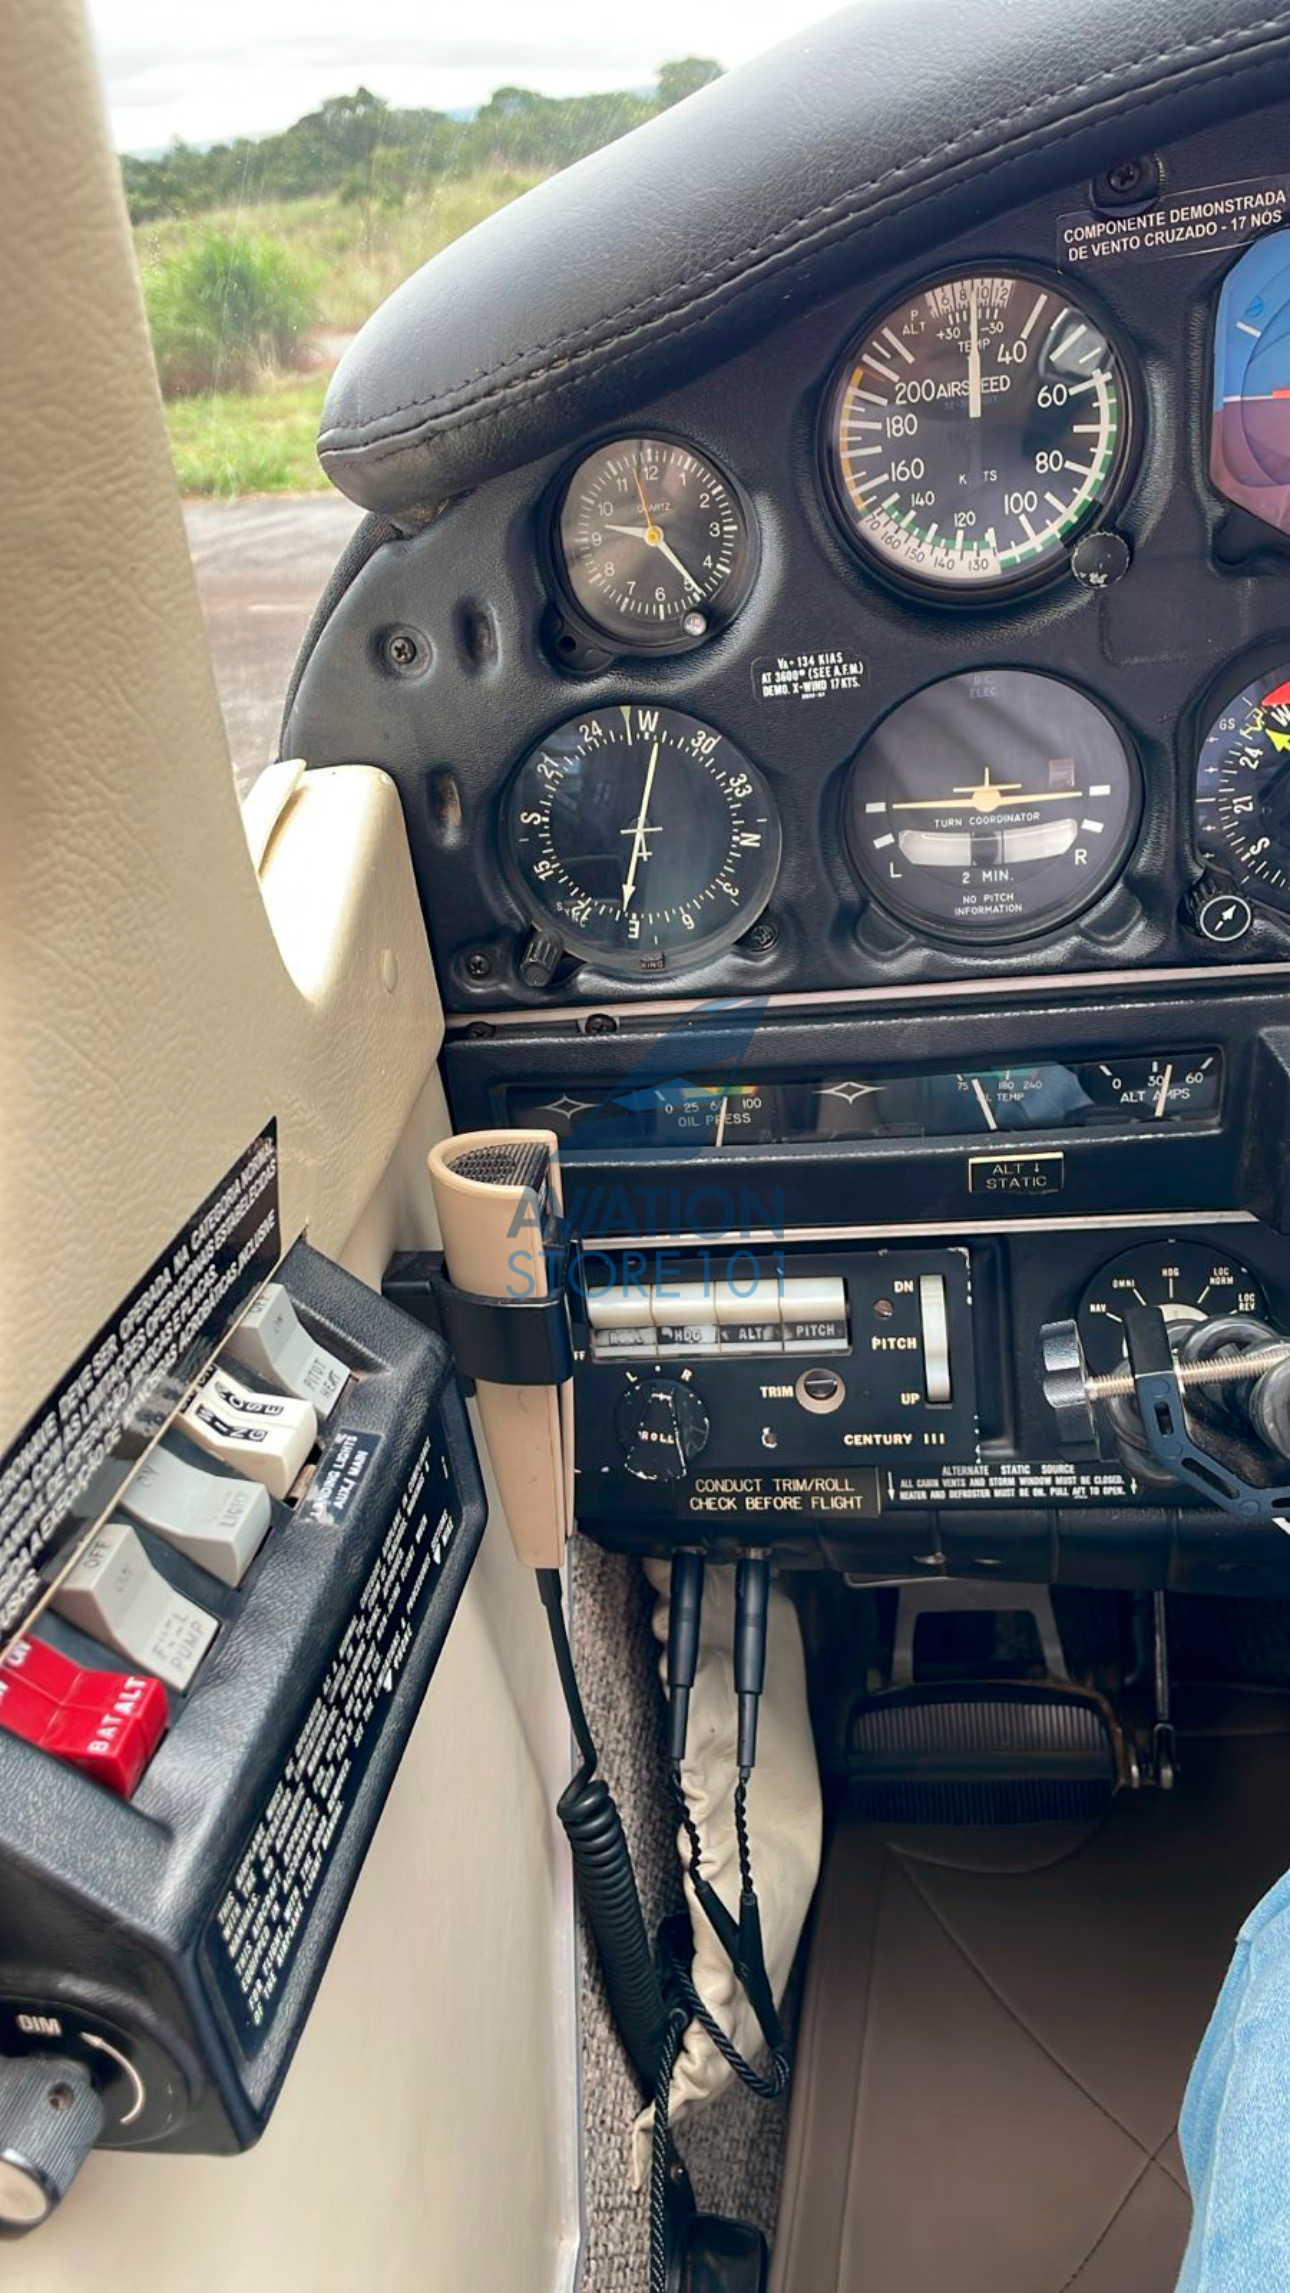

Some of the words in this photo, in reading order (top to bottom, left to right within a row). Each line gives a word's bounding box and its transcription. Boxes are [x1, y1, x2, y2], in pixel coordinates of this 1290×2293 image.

[1064, 211, 1165, 243] COMPONENTE
[1170, 190, 1286, 223] DEMONSTRADA
[1068, 246, 1088, 262] DE
[1091, 236, 1140, 257] VENTO
[1144, 222, 1217, 246] CRUZADO
[1231, 216, 1246, 231] 17
[911, 309, 918, 320] P
[902, 322, 926, 335] ALT
[936, 327, 961, 340] +30
[980, 321, 1004, 334] -30
[997, 340, 1027, 364] 40
[895, 379, 936, 404] 200
[936, 374, 1011, 399] AIRSEED
[1037, 384, 1066, 407] 60
[886, 415, 918, 438] 180
[891, 458, 924, 480] 160
[1035, 451, 1062, 474] 80
[642, 465, 659, 481] 12
[616, 478, 629, 492] 11
[699, 492, 711, 509] 2
[911, 490, 935, 506] 140
[1004, 492, 1038, 514] 100
[598, 501, 613, 516] 10
[954, 511, 976, 527] 120
[709, 521, 721, 537] 3
[591, 532, 602, 547] 9
[880, 531, 901, 550] 160
[702, 554, 713, 569] 4
[905, 546, 925, 563] 150
[604, 562, 616, 577] 8
[934, 556, 955, 570] 140
[968, 558, 989, 571] 130
[626, 581, 636, 596] 7
[654, 586, 666, 601] 6
[797, 655, 815, 668] 134
[818, 651, 843, 665] KIAS
[762, 672, 772, 684] AT
[638, 710, 659, 732] W
[1219, 718, 1236, 731] GS
[579, 720, 603, 743] 24
[691, 730, 716, 754] 30
[1239, 746, 1264, 770] 24
[537, 755, 560, 779] 21
[729, 773, 753, 798] 33
[1233, 795, 1253, 815] 21
[520, 811, 541, 825] S
[934, 817, 963, 829] TURN
[969, 811, 1040, 826] COORDINATOR
[739, 832, 761, 848] N
[1250, 836, 1271, 856] S
[1074, 848, 1088, 866] R
[533, 859, 554, 882] 15
[890, 861, 903, 879] L
[962, 871, 971, 884] 2
[982, 869, 1015, 882] MIN.
[963, 895, 978, 905] NO
[983, 893, 1015, 903] PITCH
[954, 903, 1023, 917] INFORMATION
[627, 919, 640, 939] E
[1111, 1077, 1121, 1090] 0
[1185, 1072, 1204, 1084] 60
[996, 1092, 1025, 1102] TEMP
[1120, 1090, 1146, 1104] ALT
[664, 1103, 673, 1114] 0
[683, 1102, 699, 1113] 25
[742, 1097, 762, 1109] 100
[677, 1116, 700, 1127] OIL
[992, 1163, 1023, 1176] ALT
[986, 1176, 1048, 1190] STATIC
[1213, 1267, 1229, 1276] LOC
[894, 1280, 914, 1293] DN
[1112, 1279, 1135, 1288] OMNI
[1209, 1276, 1234, 1285] NORM
[59, 1359, 94, 1419] DEVE
[91, 1334, 117, 1383] SER
[120, 1268, 171, 1339] OPERADA
[173, 1245, 189, 1273] NA
[191, 1179, 240, 1249] CATEGORIA
[1237, 1293, 1256, 1302] LOC
[1090, 1304, 1107, 1313] NAV
[1238, 1301, 1256, 1311] REV
[674, 1328, 701, 1342] HDG
[738, 1326, 763, 1340] ALT
[796, 1323, 835, 1338] PITCH
[871, 1336, 918, 1350] PITCH
[303, 1358, 327, 1390] PITOT
[681, 1368, 693, 1382] R
[320, 1370, 342, 1398] HEAT
[760, 1386, 794, 1399] TRIM
[900, 1392, 921, 1405] UP
[641, 1431, 675, 1444] ROLL
[843, 1433, 912, 1446] CENTURY
[923, 1432, 945, 1445] III
[333, 1435, 358, 1470] LIGHTS
[347, 1450, 369, 1476] MAIN
[942, 1465, 989, 1476] ALTERNATE
[1000, 1465, 1031, 1475] STATIC
[1041, 1464, 1075, 1474] SOURCE
[695, 1478, 761, 1493] CONDUCT
[773, 1477, 855, 1493] TRIM/ROLL
[900, 1479, 913, 1488] ALL
[942, 1478, 966, 1488] VENTS
[970, 1477, 986, 1486] AND
[988, 1477, 1016, 1486] STORM
[899, 1490, 927, 1500] HEATER
[930, 1490, 945, 1499] AND
[948, 1489, 990, 1499] DEFROSTER
[993, 1488, 1015, 1498] MUST
[1050, 1486, 1069, 1496] PULL
[217, 1491, 248, 1527] LIGHT
[690, 1496, 739, 1511] CHECK
[746, 1495, 804, 1511] BEFORE
[811, 1495, 863, 1511] FLIGHT
[83, 1538, 113, 1569] OFF
[169, 1620, 206, 1669] PUMP
[87, 1714, 123, 1755] BAT
[113, 1676, 147, 1717] ALT
[252, 1870, 280, 1938] AIRCRAFT
[276, 1900, 303, 1966] AIRPLANE
[303, 1850, 321, 1897] FLIGHT
[248, 1979, 262, 2010] FOR
[262, 1926, 282, 1975] FLIGHT
[283, 1886, 299, 1920] WITH
[16, 2013, 63, 2037] DIM
